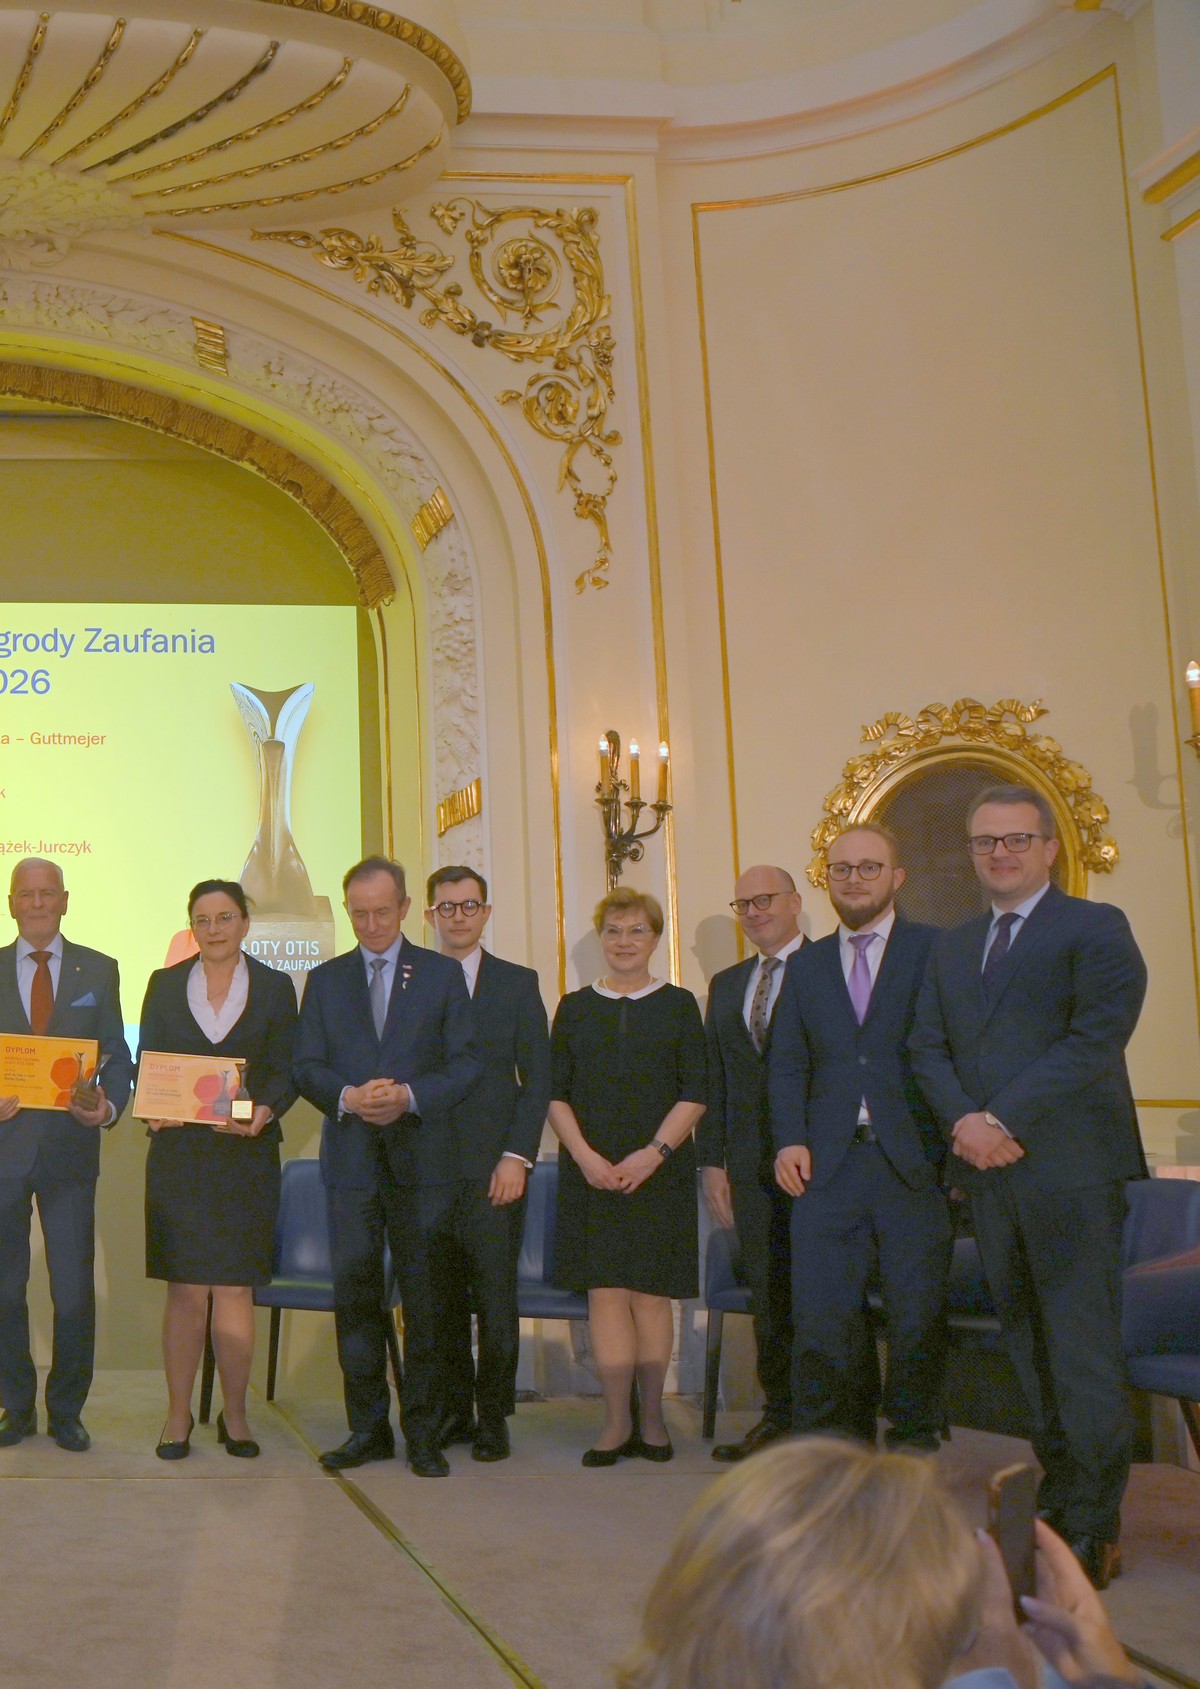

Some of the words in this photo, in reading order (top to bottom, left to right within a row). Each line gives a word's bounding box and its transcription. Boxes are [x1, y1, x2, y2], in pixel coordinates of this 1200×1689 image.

[84, 627, 216, 654] Zaufania
[29, 732, 107, 748] Guttmejer
[240, 940, 280, 956] ŁOTY
[285, 941, 319, 956] OTIS
[277, 959, 327, 971] ZAUFAN
[5, 1046, 36, 1055] DYPLOM
[149, 1063, 181, 1072] DYPLOM
